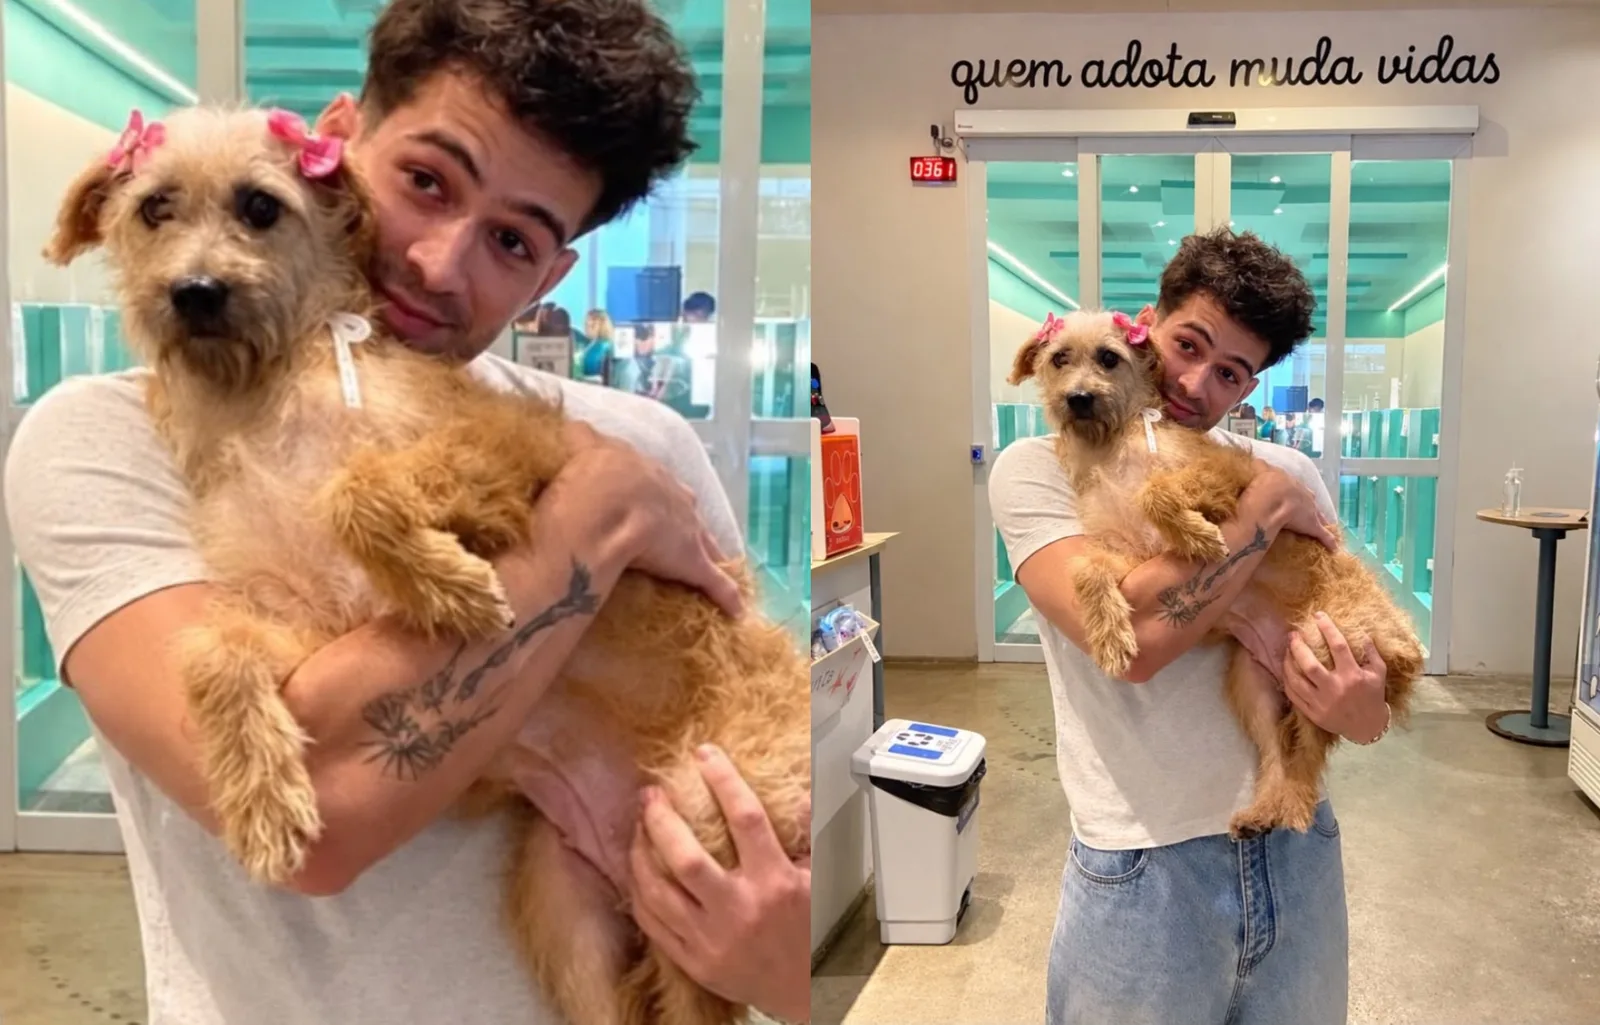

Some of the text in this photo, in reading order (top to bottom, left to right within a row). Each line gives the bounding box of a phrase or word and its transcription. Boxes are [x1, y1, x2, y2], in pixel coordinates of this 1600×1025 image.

[950, 34, 1501, 106] quem adota muda vidas
[913, 161, 954, 178] 0361
